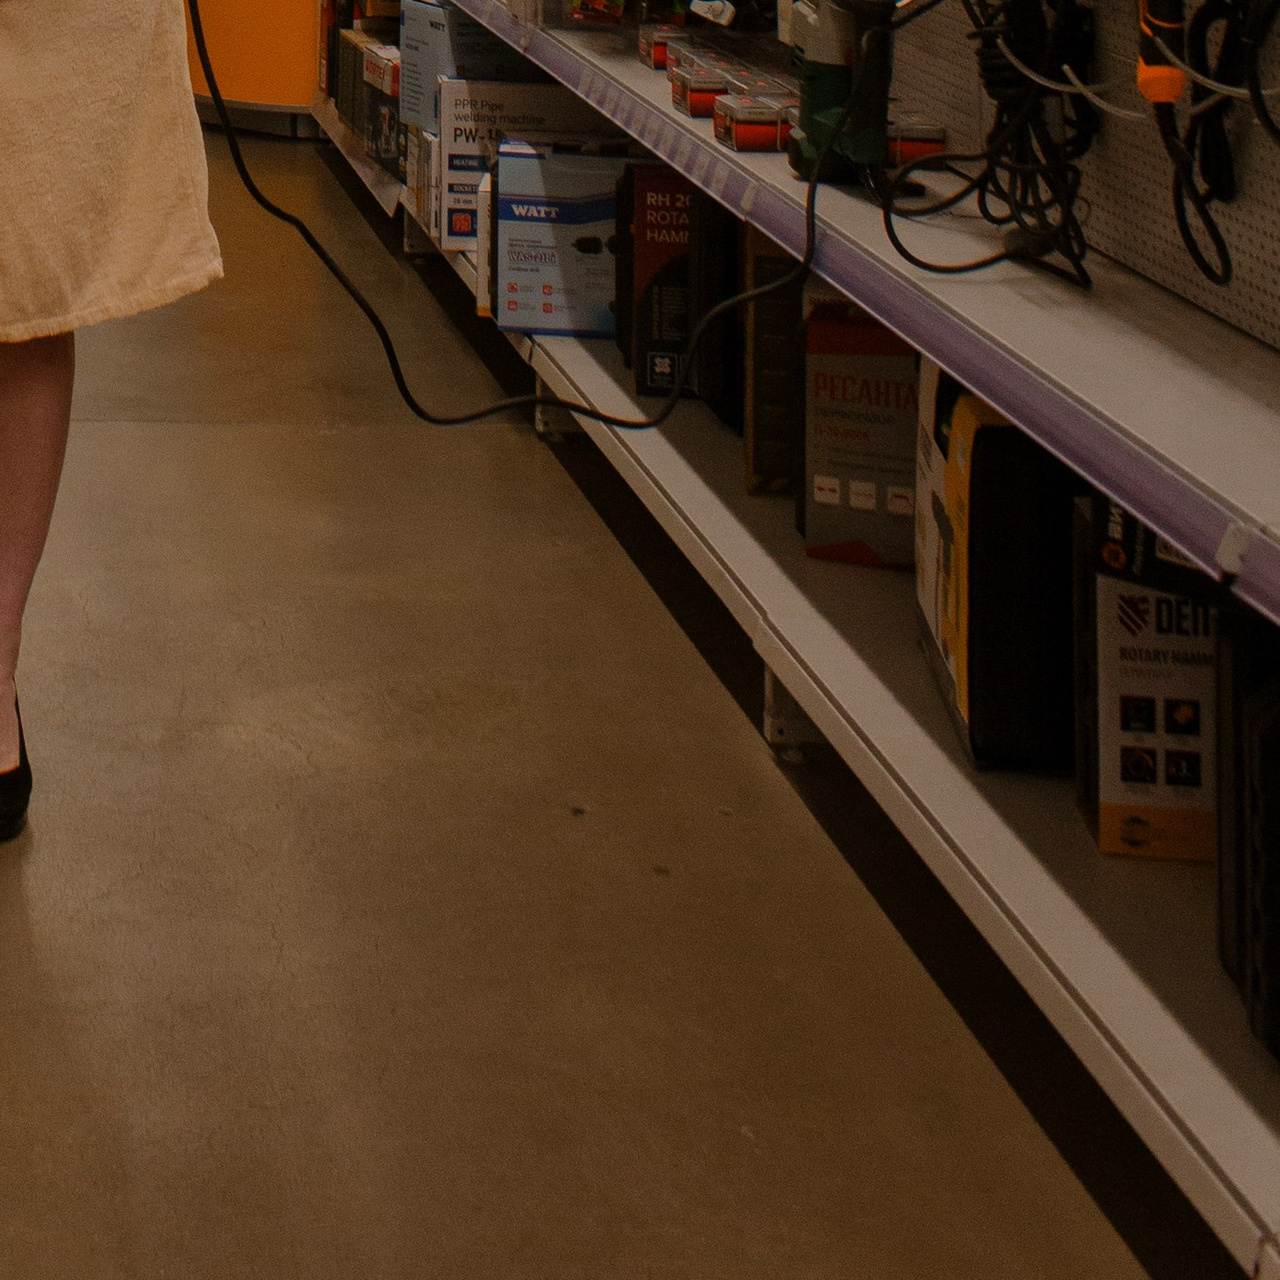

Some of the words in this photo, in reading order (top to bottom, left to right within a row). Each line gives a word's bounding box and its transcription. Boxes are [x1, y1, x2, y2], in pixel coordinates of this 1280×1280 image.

[454, 98, 478, 111] PPR
[480, 100, 504, 113] Pipe
[453, 112, 497, 126] welding
[499, 114, 546, 125] machine
[646, 191, 670, 207] RH
[510, 203, 560, 219] WATT
[646, 210, 691, 226] ROTA
[814, 372, 919, 411] РЕСАНТА
